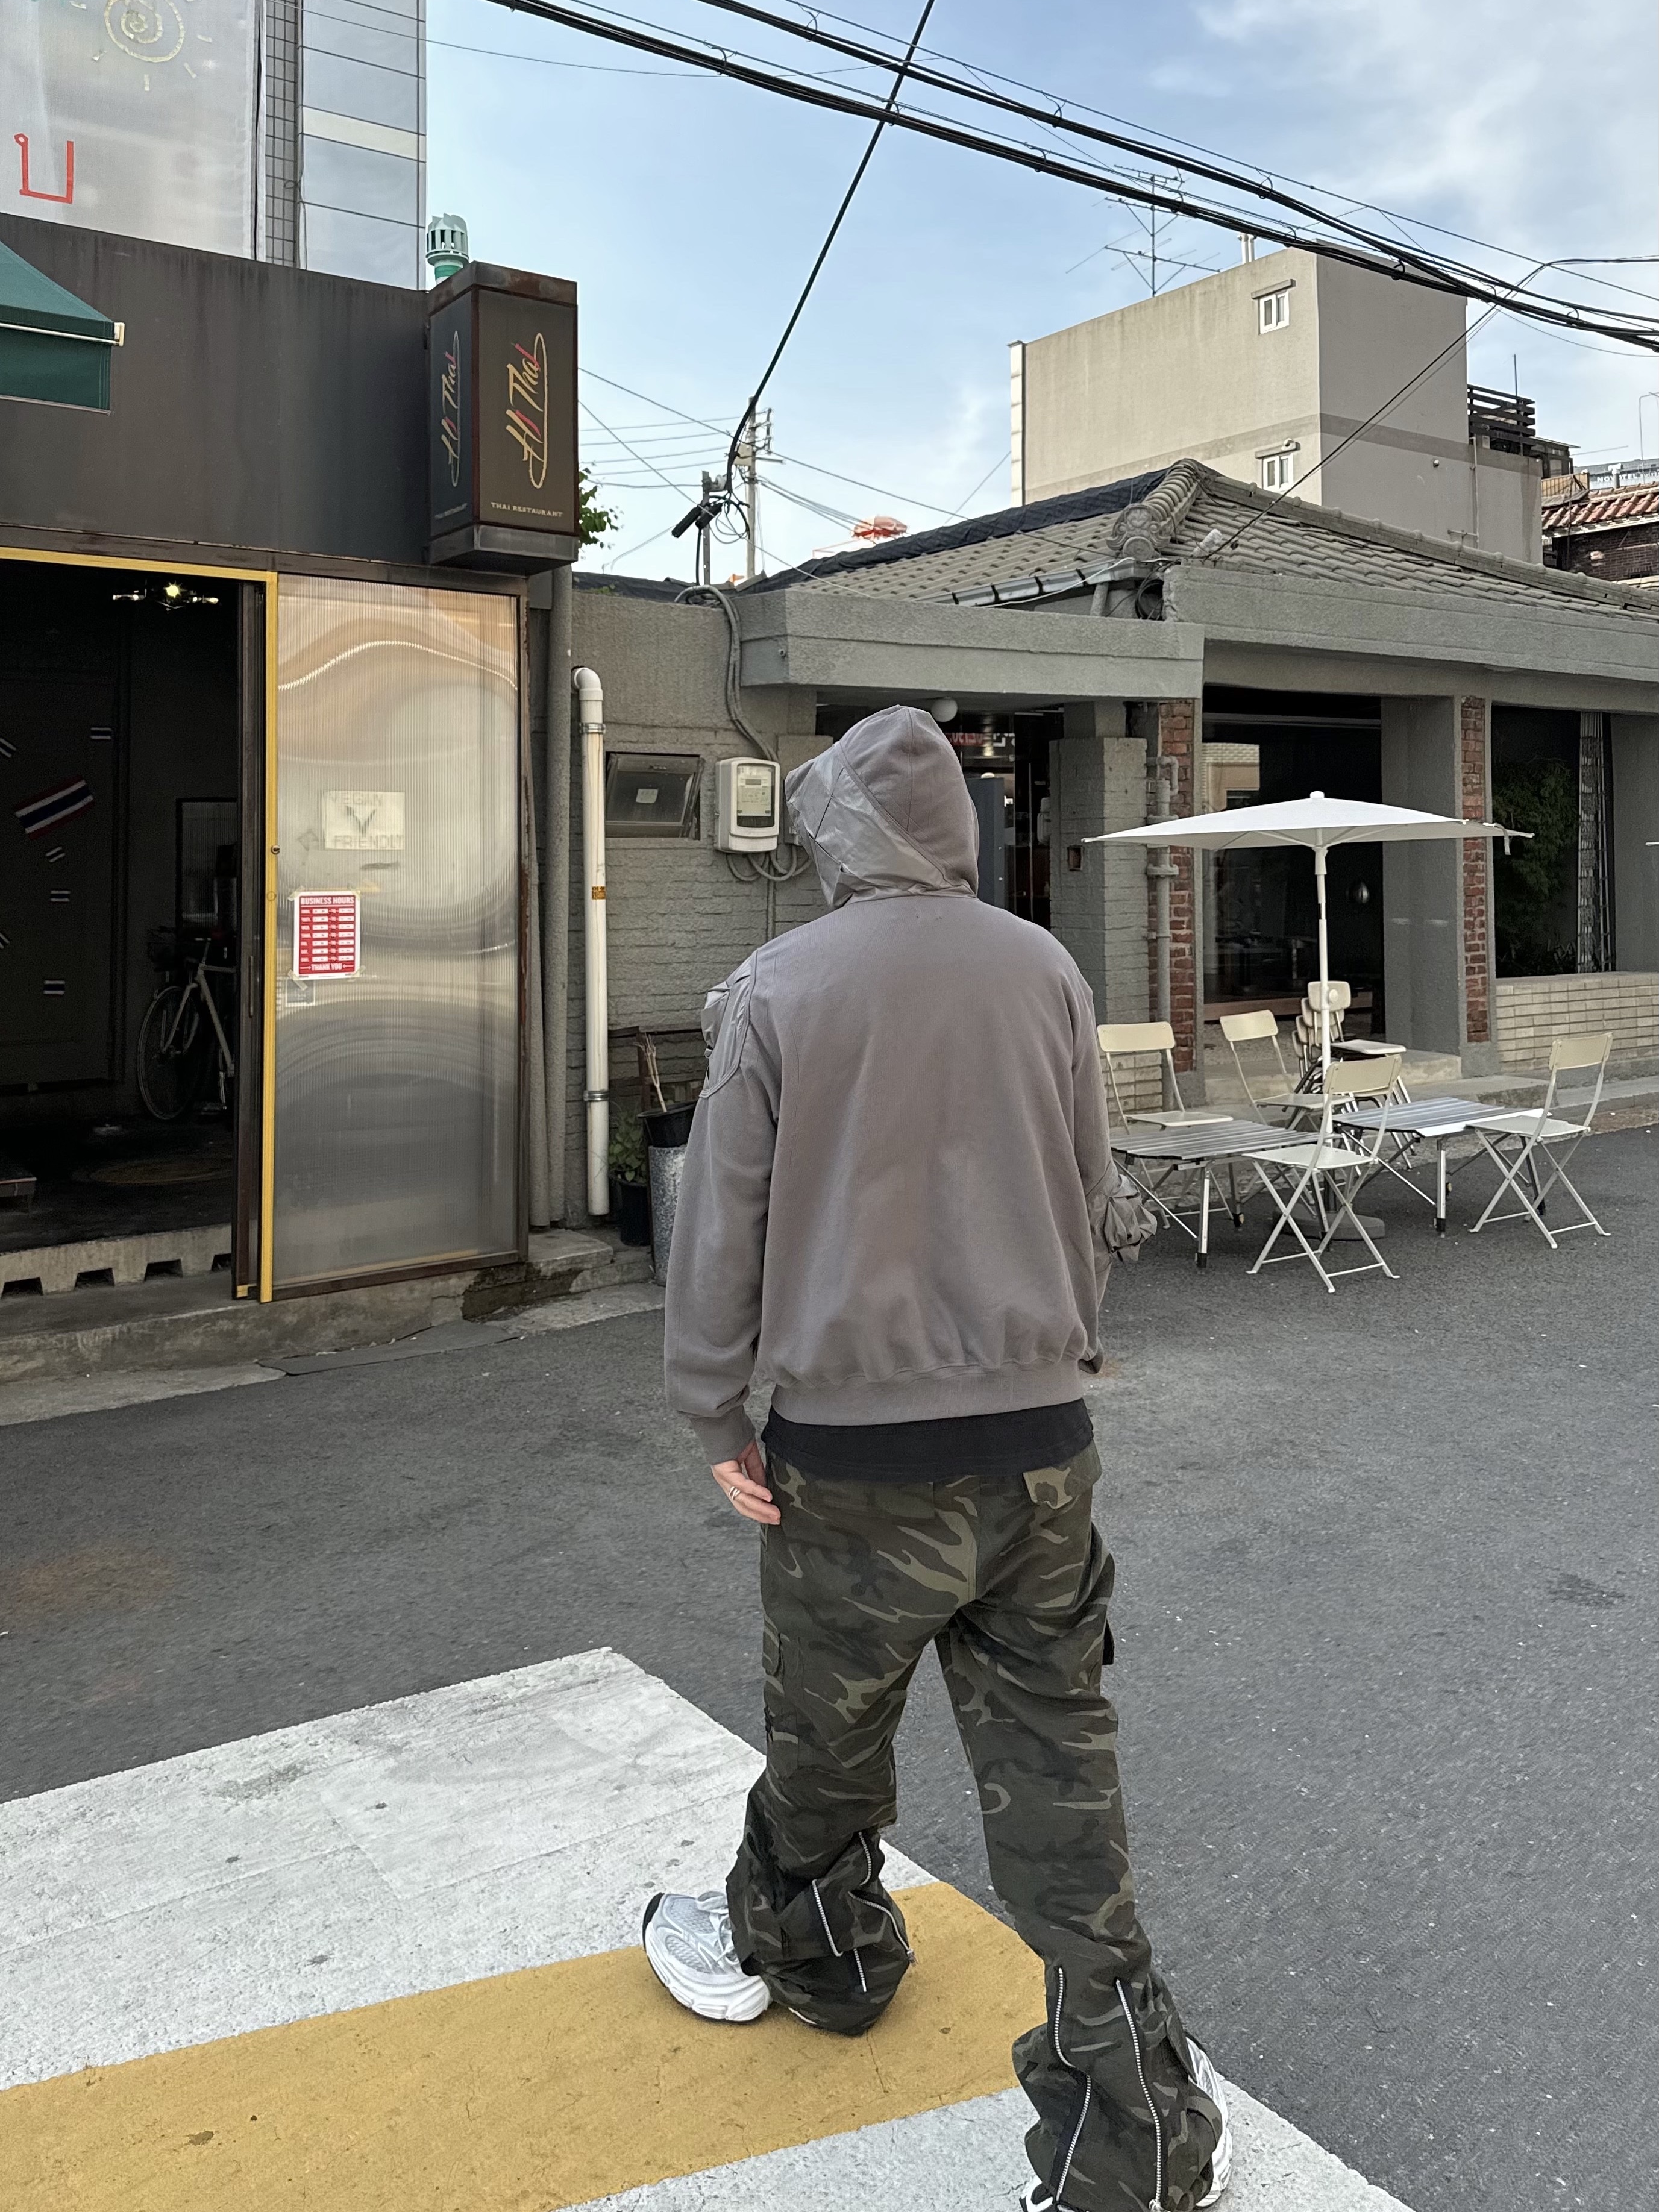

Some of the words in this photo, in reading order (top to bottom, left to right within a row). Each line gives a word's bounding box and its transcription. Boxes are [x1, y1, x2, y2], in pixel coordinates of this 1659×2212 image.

[491, 502, 511, 510] THAI
[512, 506, 563, 518] RESTAURANT
[333, 834, 404, 848] FRIENDLY
[300, 897, 332, 905] BUSINESS
[332, 896, 354, 904] HOURS
